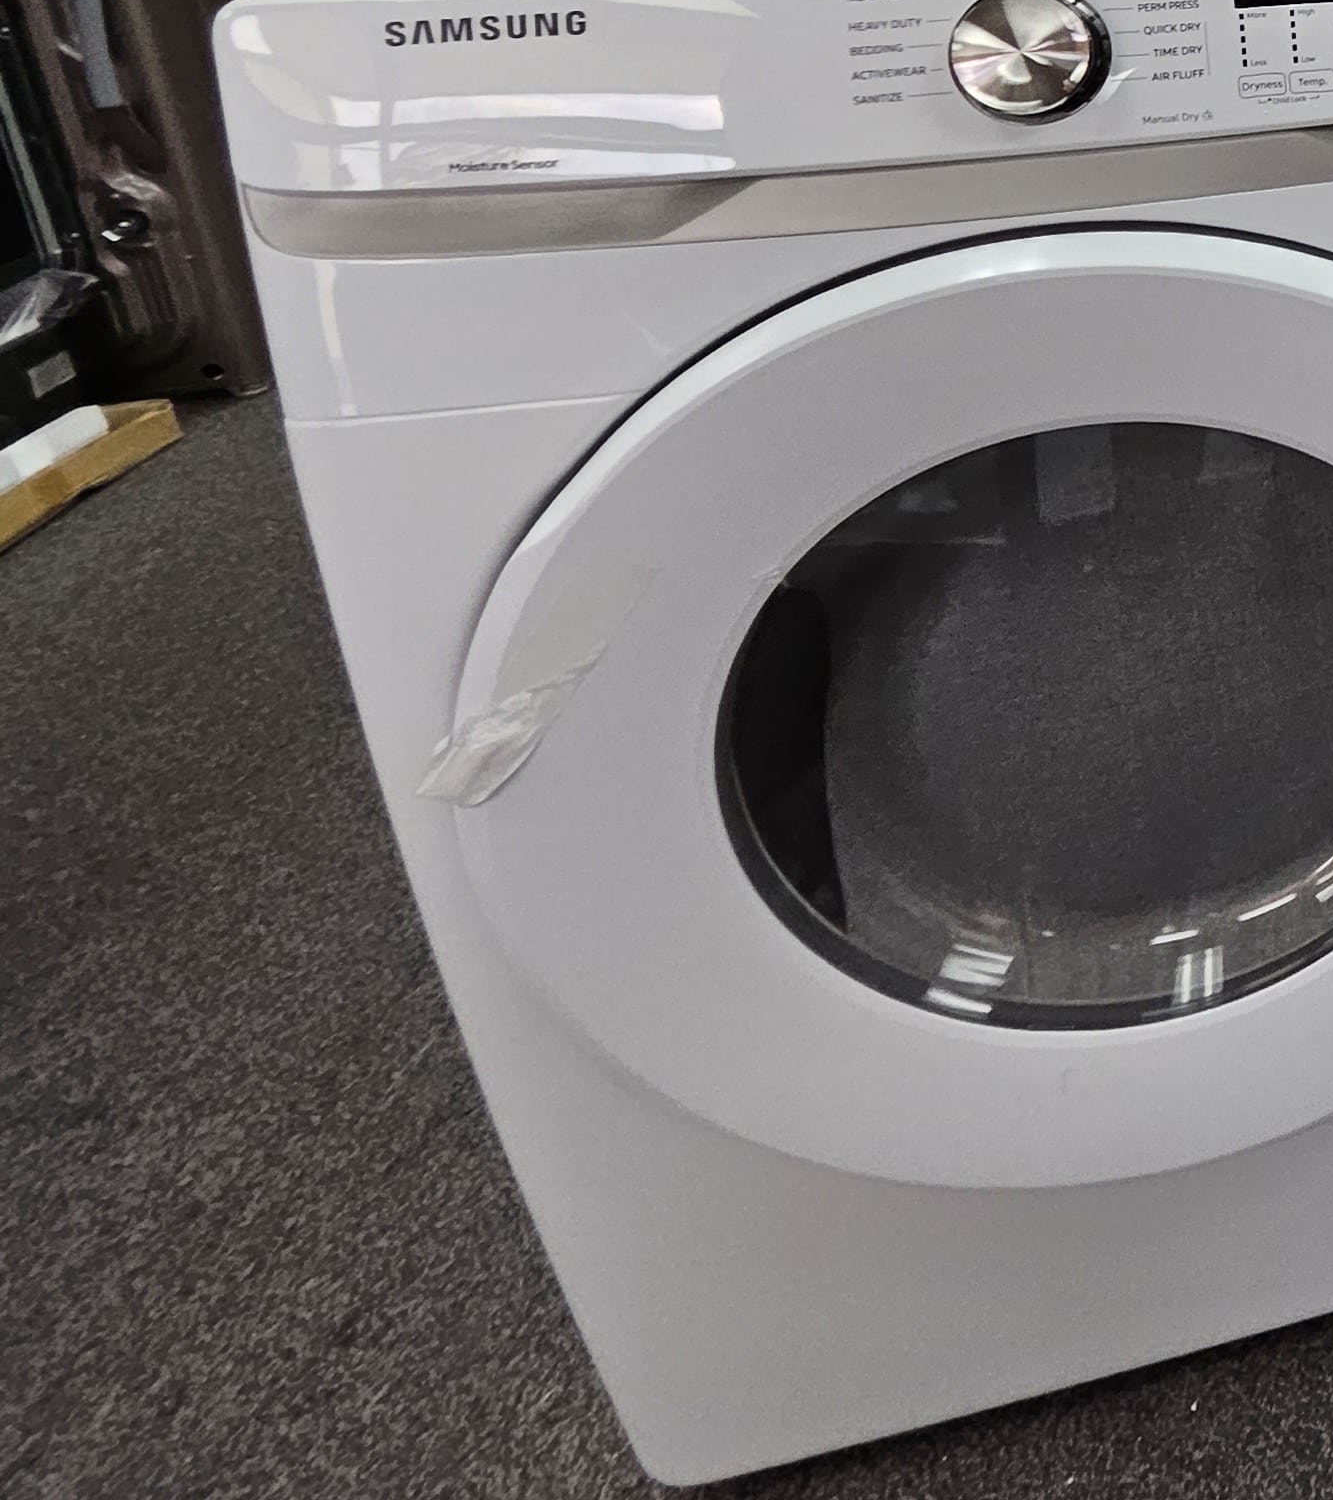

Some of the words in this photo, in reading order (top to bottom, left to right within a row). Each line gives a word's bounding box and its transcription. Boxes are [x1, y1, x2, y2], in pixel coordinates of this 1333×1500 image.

[1138, 2, 1166, 12] PERM
[1169, 0, 1200, 10] PRESS
[385, 10, 587, 47] SAMSUNG
[847, 21, 889, 32] HEAVY
[890, 18, 923, 29] DUTY
[1143, 23, 1178, 35] QUICK
[1179, 22, 1201, 33] DRY
[849, 43, 905, 56] BEDDING
[1153, 47, 1179, 57] TIME
[1181, 45, 1203, 56] DRY
[851, 65, 928, 80] ACTIVEWEAR
[1152, 71, 1170, 81] AIR
[1172, 69, 1205, 80] FLUFF
[1242, 80, 1283, 92] Dryness
[852, 92, 904, 105] SANITIZE
[1142, 112, 1180, 125] Manual
[1181, 112, 1200, 123] Dry
[448, 161, 509, 173] Moisture
[510, 159, 560, 171] Sensor
